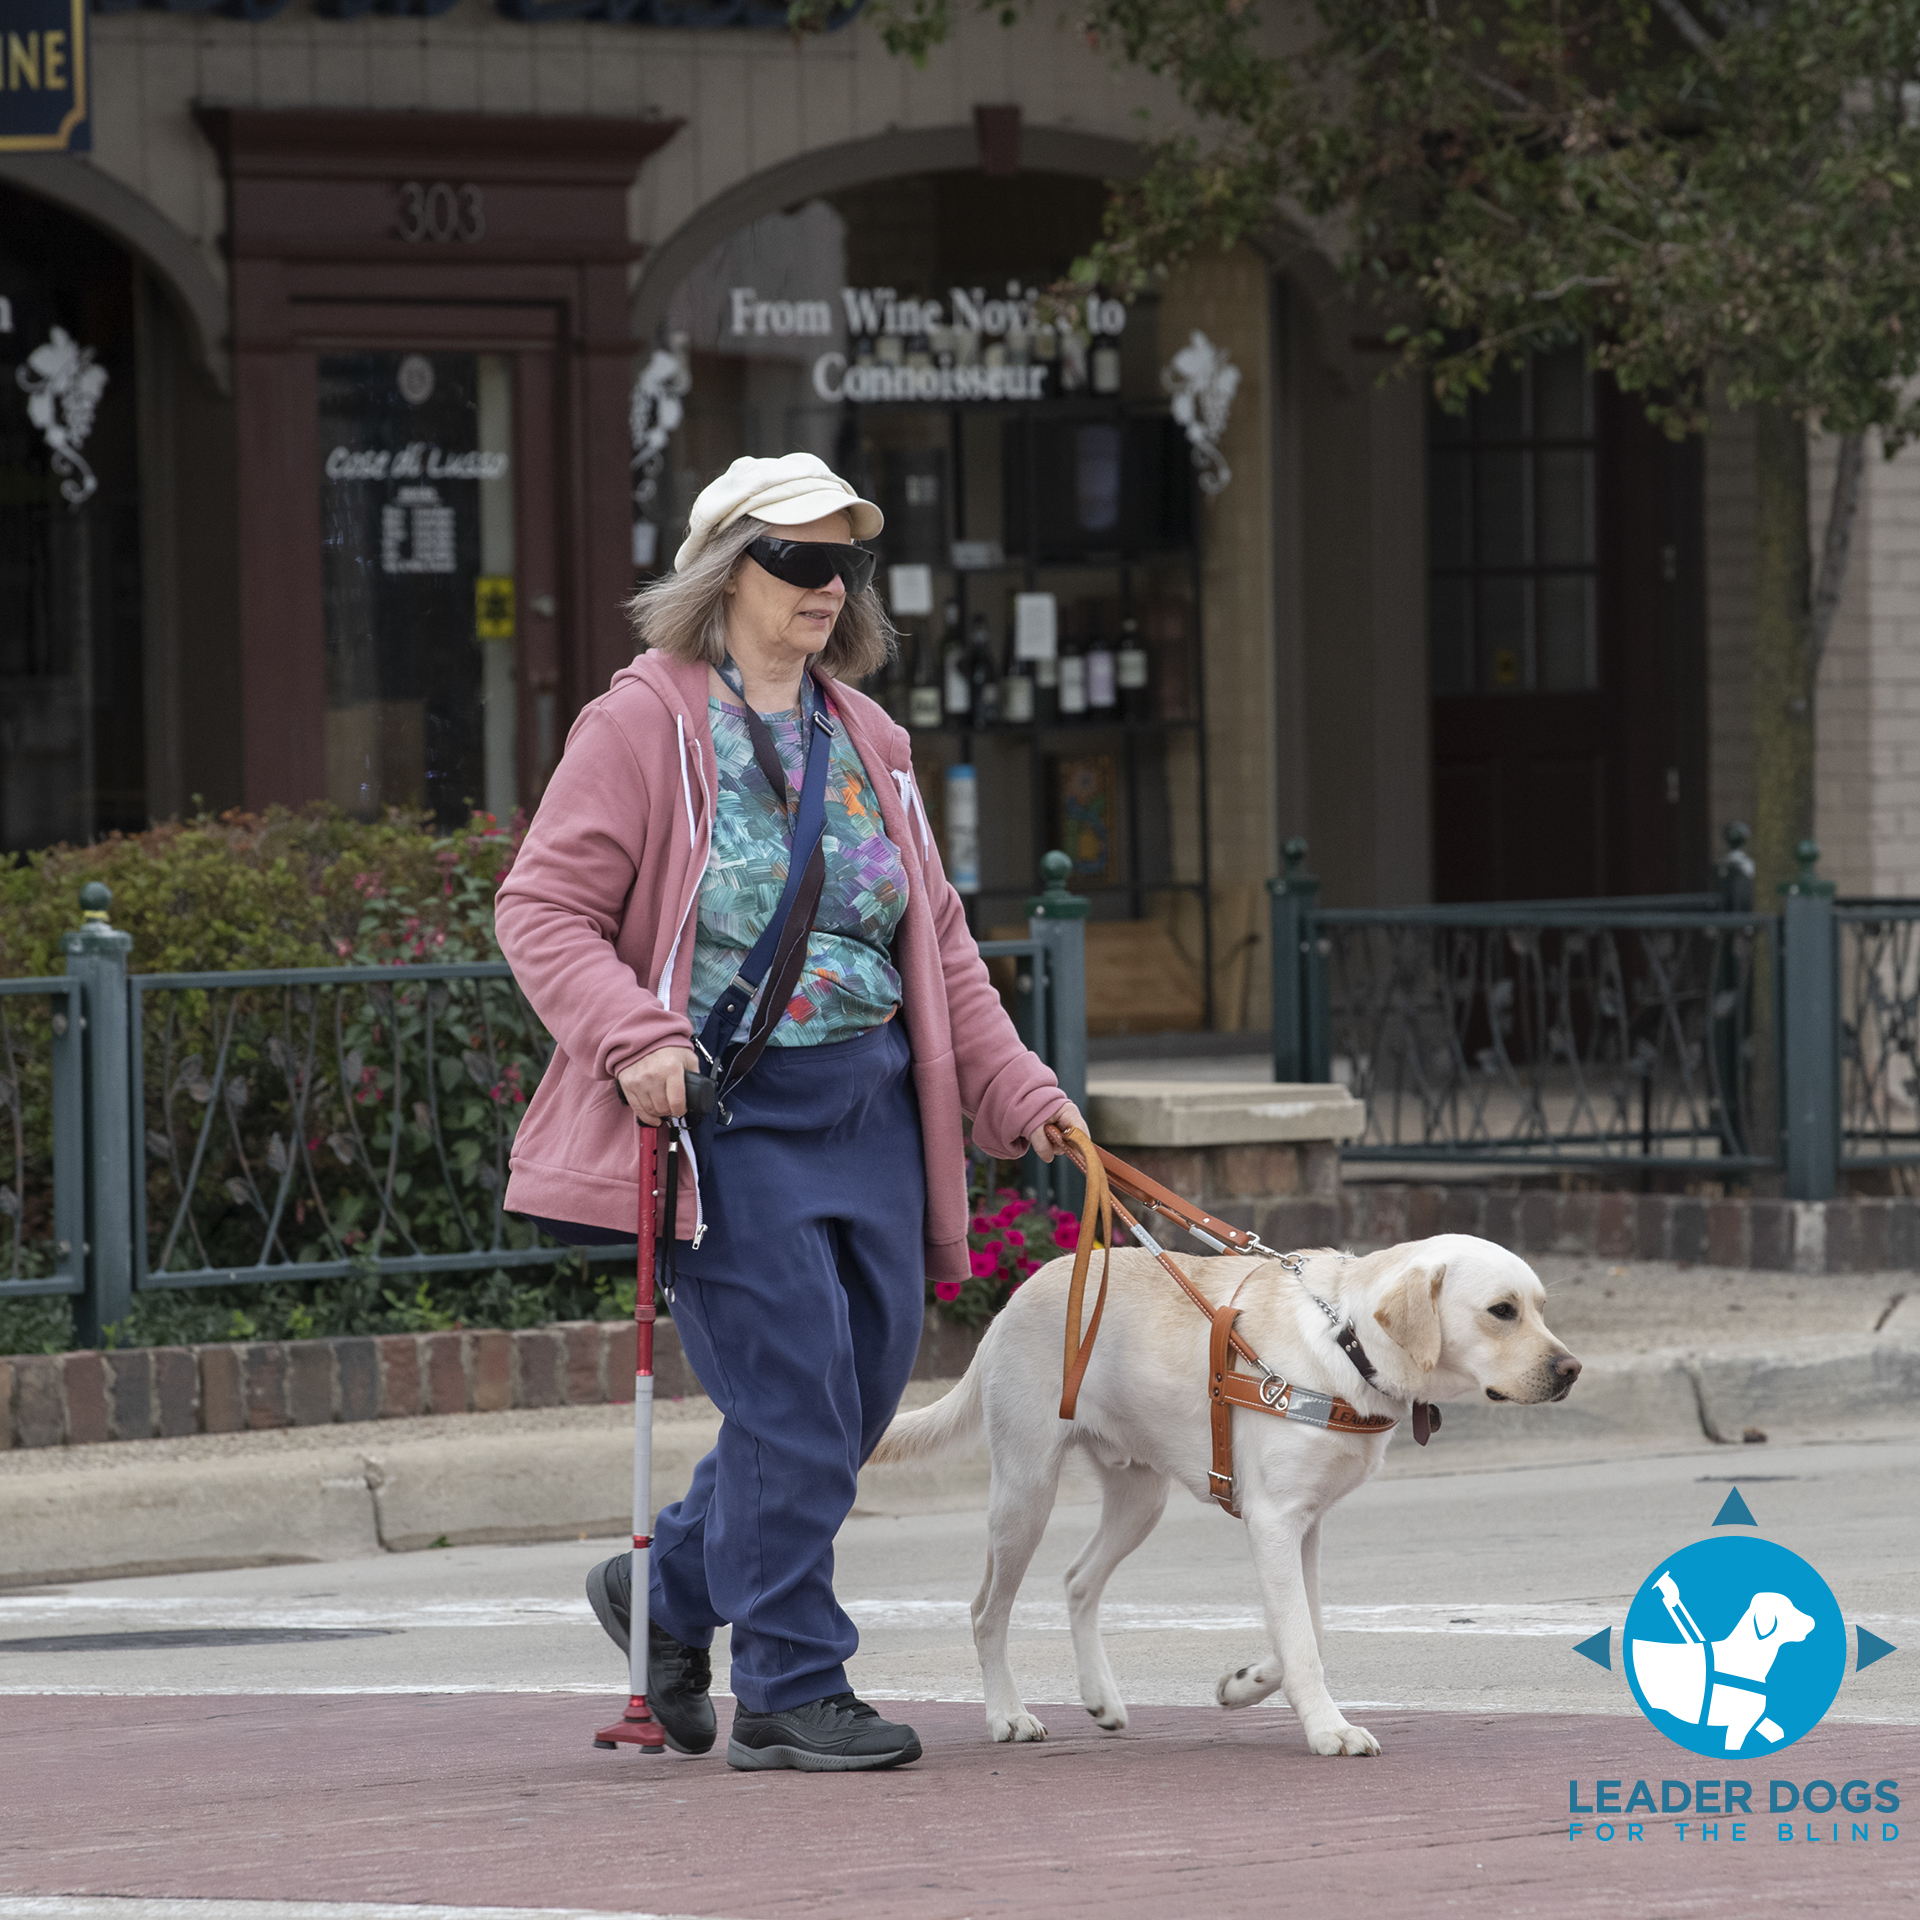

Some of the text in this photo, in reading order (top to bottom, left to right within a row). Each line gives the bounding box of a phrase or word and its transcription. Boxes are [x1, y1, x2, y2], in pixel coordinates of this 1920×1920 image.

[399, 181, 486, 243] 303
[730, 286, 1126, 335] From Wine Novie to
[812, 350, 1048, 403] Connoisseur
[391, 441, 426, 479] di
